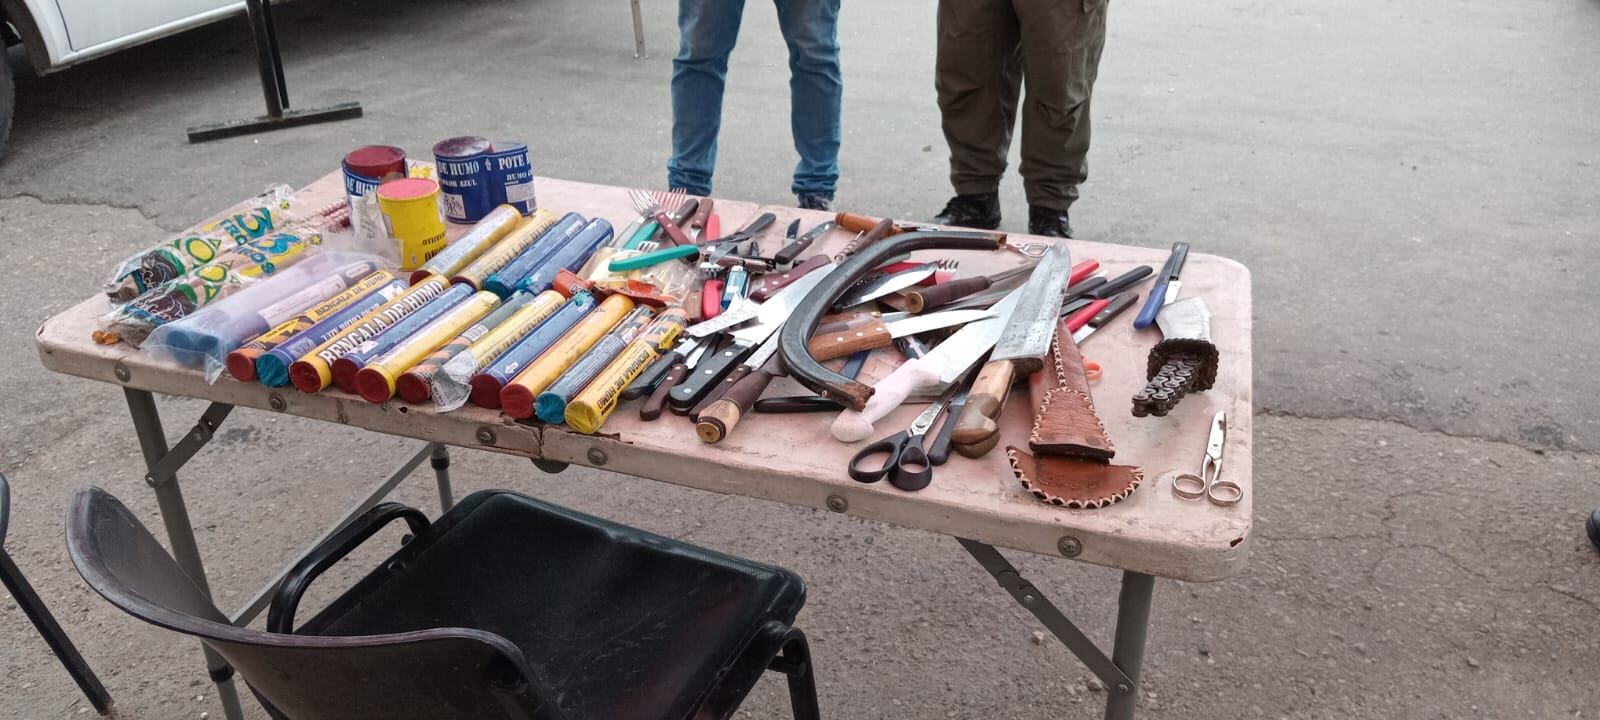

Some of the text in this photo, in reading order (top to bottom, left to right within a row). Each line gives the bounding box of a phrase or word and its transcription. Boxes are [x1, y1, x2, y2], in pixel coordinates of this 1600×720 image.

[449, 161, 480, 176] HUMO
[498, 154, 525, 171] POTE
[459, 179, 478, 189] AZUL
[506, 173, 527, 181] HUMO
[315, 293, 353, 317] BENGALA
[352, 284, 366, 296] DE
[318, 316, 389, 366] BENGALA
[384, 301, 408, 324] DE
[404, 280, 446, 311] HUMO
[623, 349, 651, 380] BENGALA
[614, 376, 626, 391] DE
[596, 386, 617, 410] HUMO
